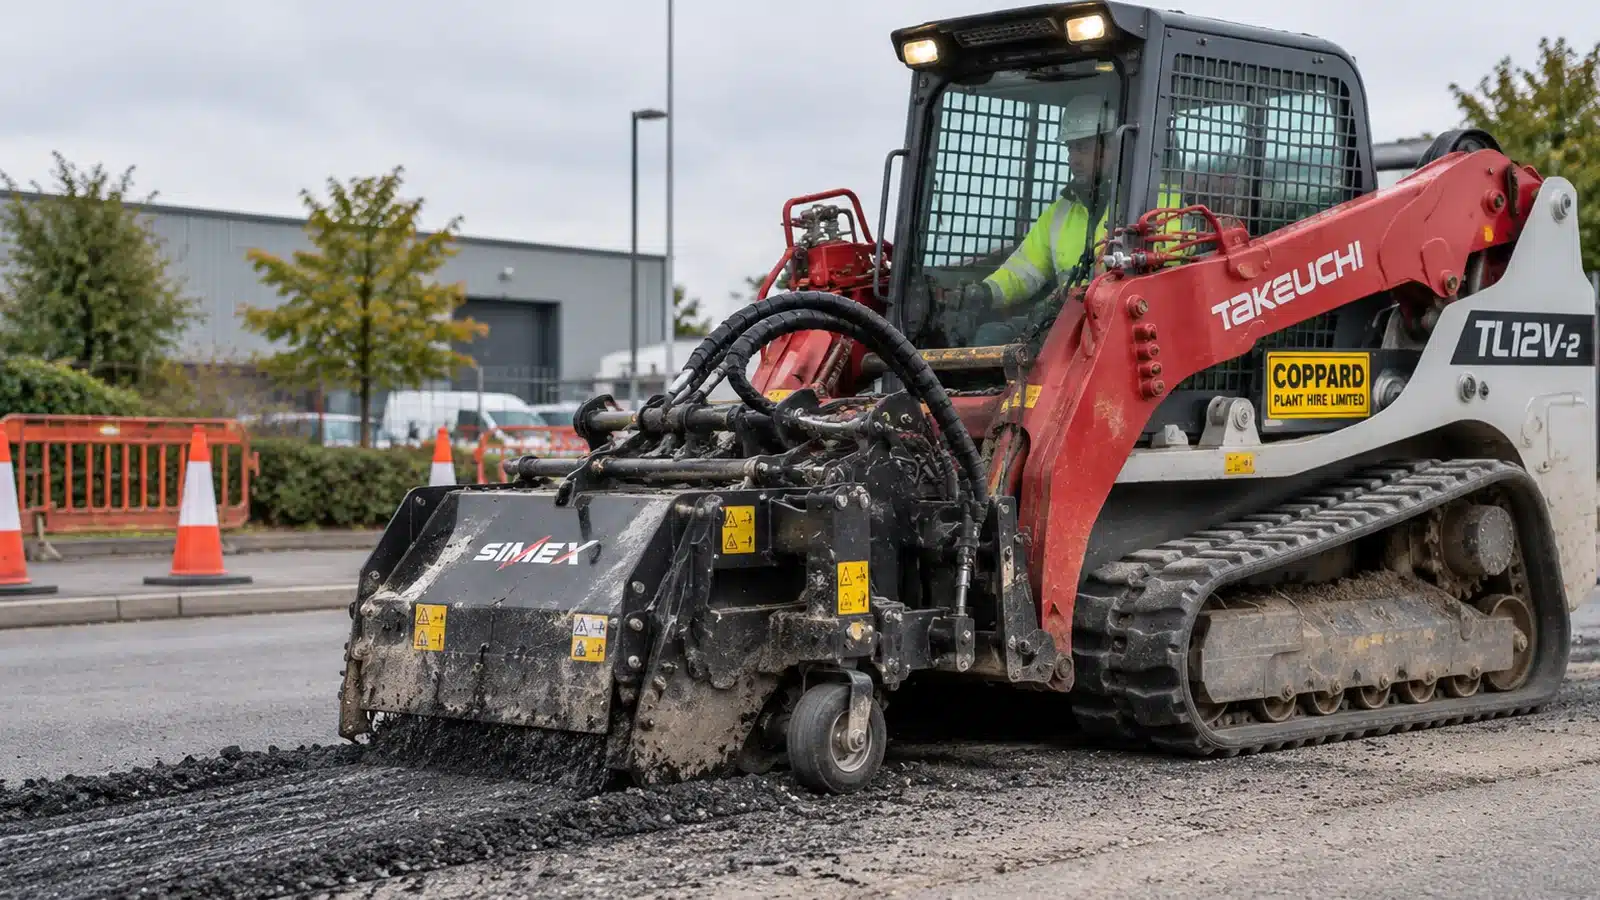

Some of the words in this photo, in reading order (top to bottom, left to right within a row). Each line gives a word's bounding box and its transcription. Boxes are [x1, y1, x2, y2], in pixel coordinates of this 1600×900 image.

[1211, 240, 1364, 331] TAKEUCHI
[1475, 320, 1581, 358] TL12V-2
[1273, 363, 1365, 389] COPPARD
[1274, 394, 1303, 407] PLANT
[1307, 394, 1328, 406] HIRE
[1331, 394, 1365, 406] LIMITED
[473, 537, 599, 569] SIMEX
